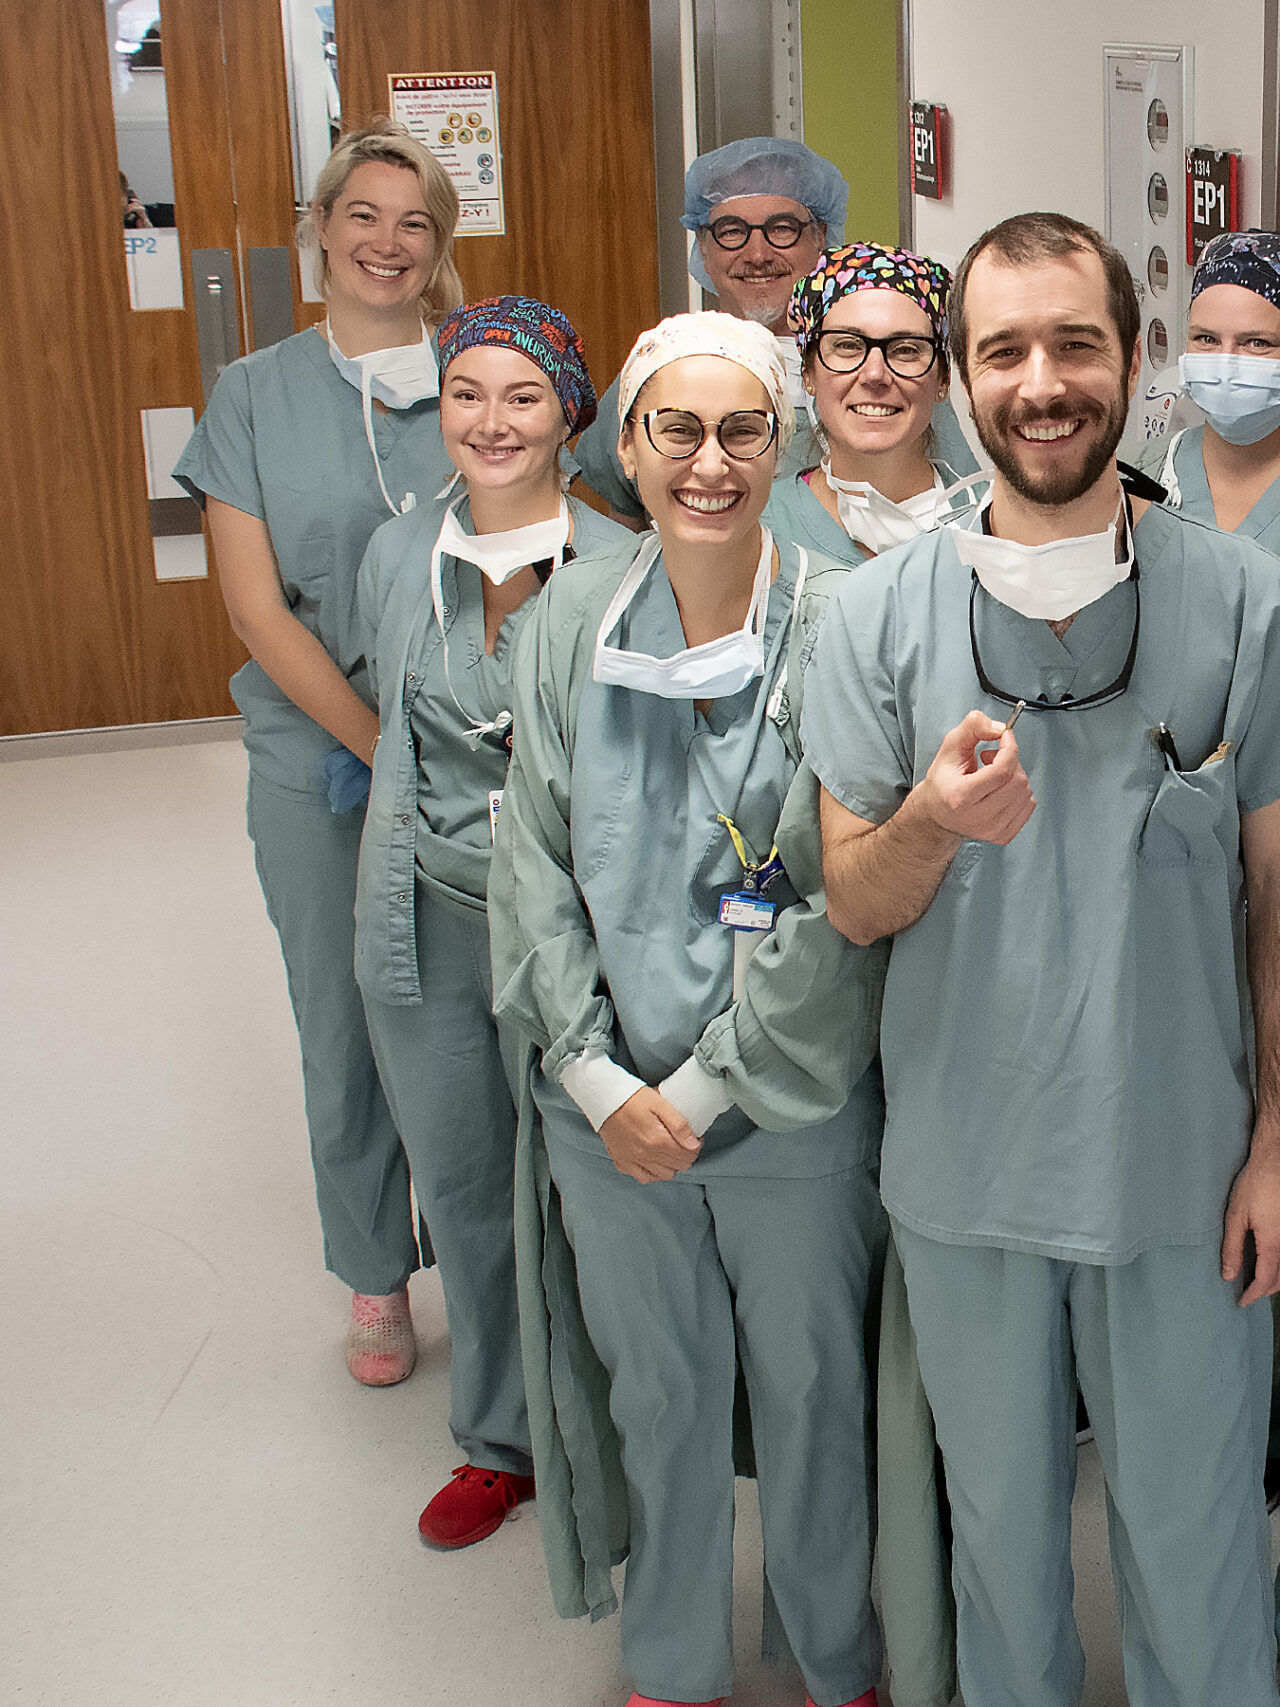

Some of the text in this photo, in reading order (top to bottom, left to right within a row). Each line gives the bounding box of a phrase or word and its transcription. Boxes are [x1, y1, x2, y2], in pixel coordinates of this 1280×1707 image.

[396, 77, 489, 88] ATTENTION
[914, 127, 935, 164] EP1
[1194, 160, 1211, 177] 1314
[1193, 180, 1225, 228] EP1
[484, 329, 511, 341] OPEN
[511, 331, 561, 381] ANEURYSM
